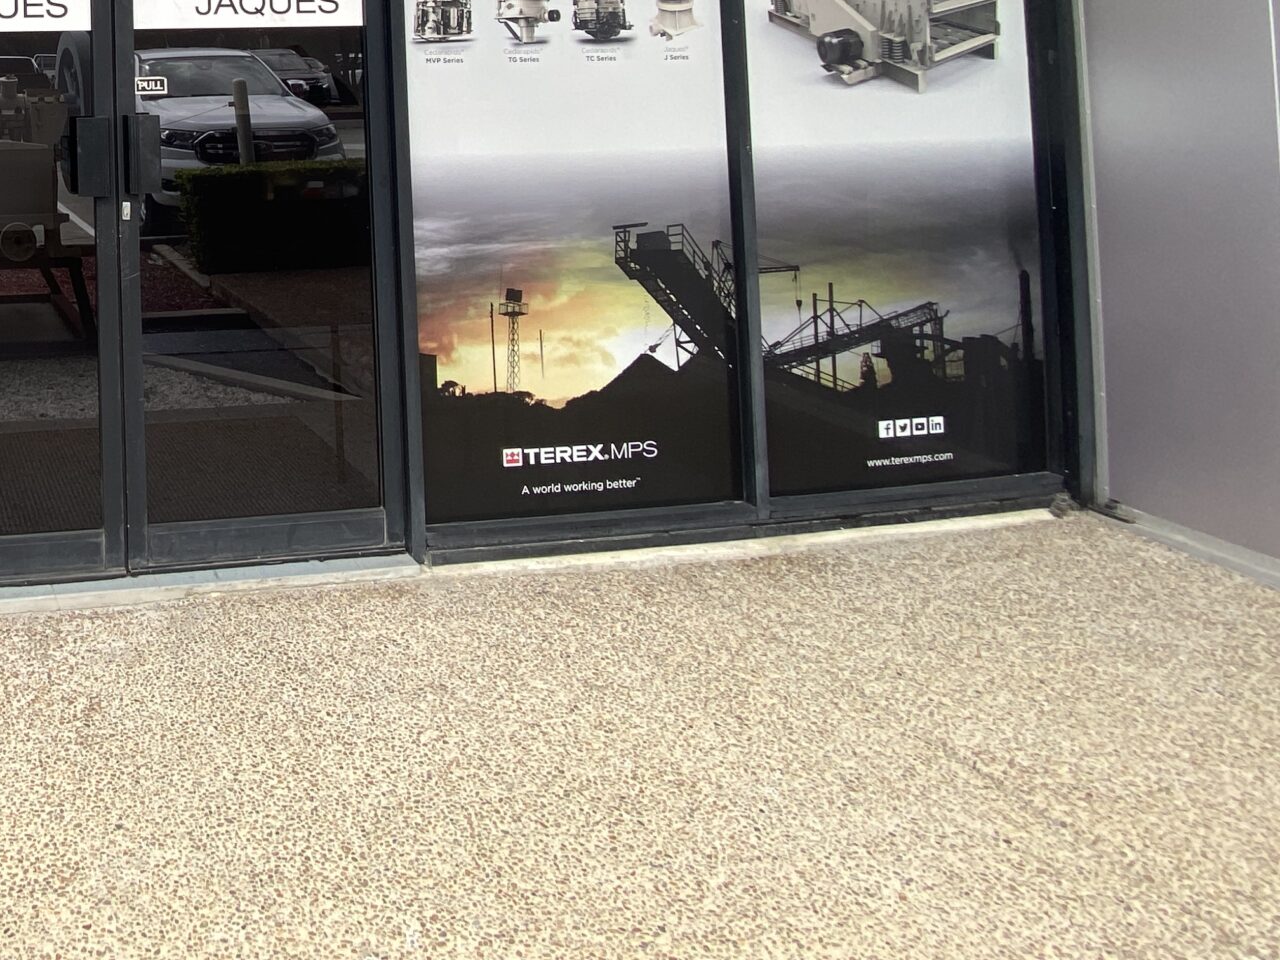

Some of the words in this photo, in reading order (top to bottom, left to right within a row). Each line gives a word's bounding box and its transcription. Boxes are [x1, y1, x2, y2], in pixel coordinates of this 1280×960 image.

[137, 80, 164, 90] PULL
[867, 452, 954, 467] www.terexmps.com
[521, 485, 530, 495] A
[532, 483, 561, 495] world
[564, 480, 604, 492] working
